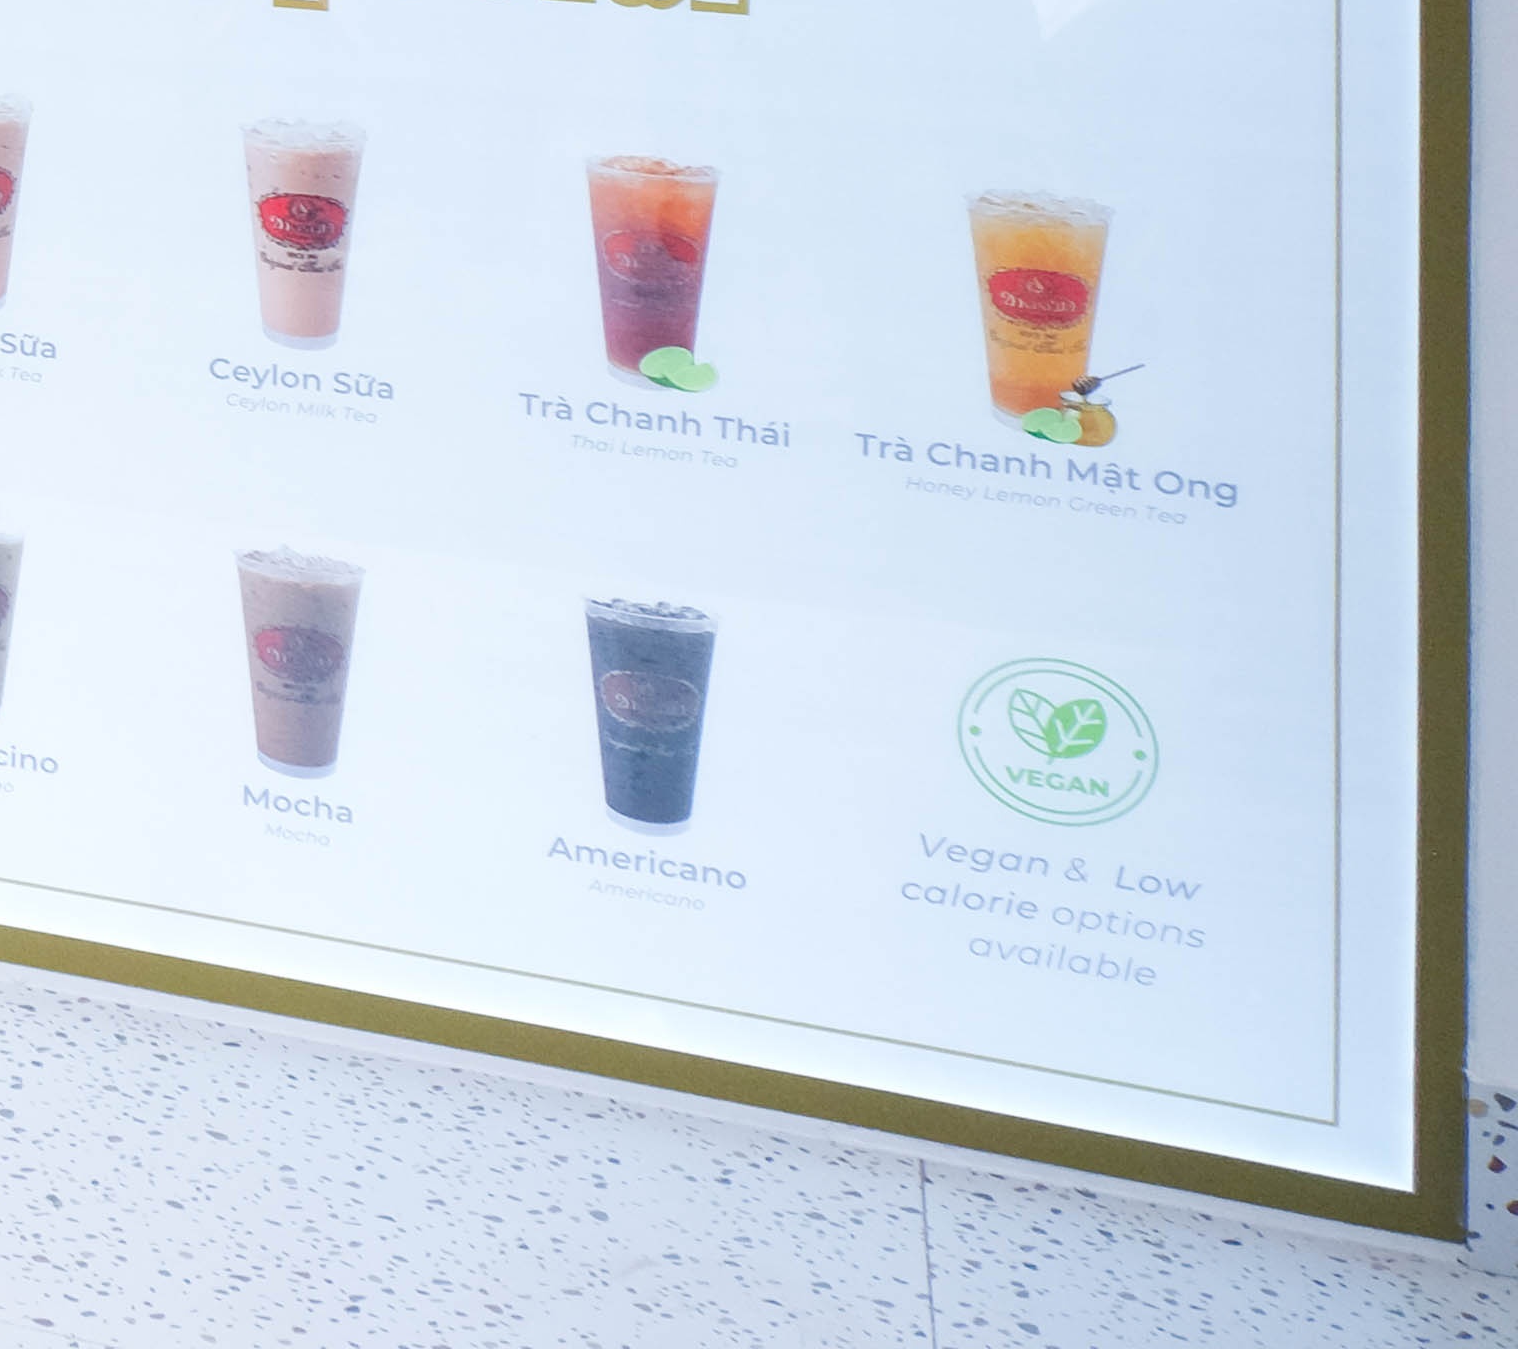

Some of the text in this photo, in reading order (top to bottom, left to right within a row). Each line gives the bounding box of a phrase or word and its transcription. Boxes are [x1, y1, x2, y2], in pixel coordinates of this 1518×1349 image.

[0, 329, 59, 361] Sữa
[208, 356, 396, 401] Ceylon Sữa
[225, 392, 293, 417] Ceylon
[297, 400, 337, 421] Milk
[518, 391, 793, 450] Trà Chanh Thái
[854, 432, 1241, 509] Trà Chanh Mật Ong
[242, 784, 355, 826] Mocha
[1004, 765, 1111, 798] VEGAN
[546, 836, 748, 891] Americano
[919, 832, 1203, 902] Vegan & Low
[900, 881, 1207, 950] calorie options
[967, 934, 1159, 988] available
